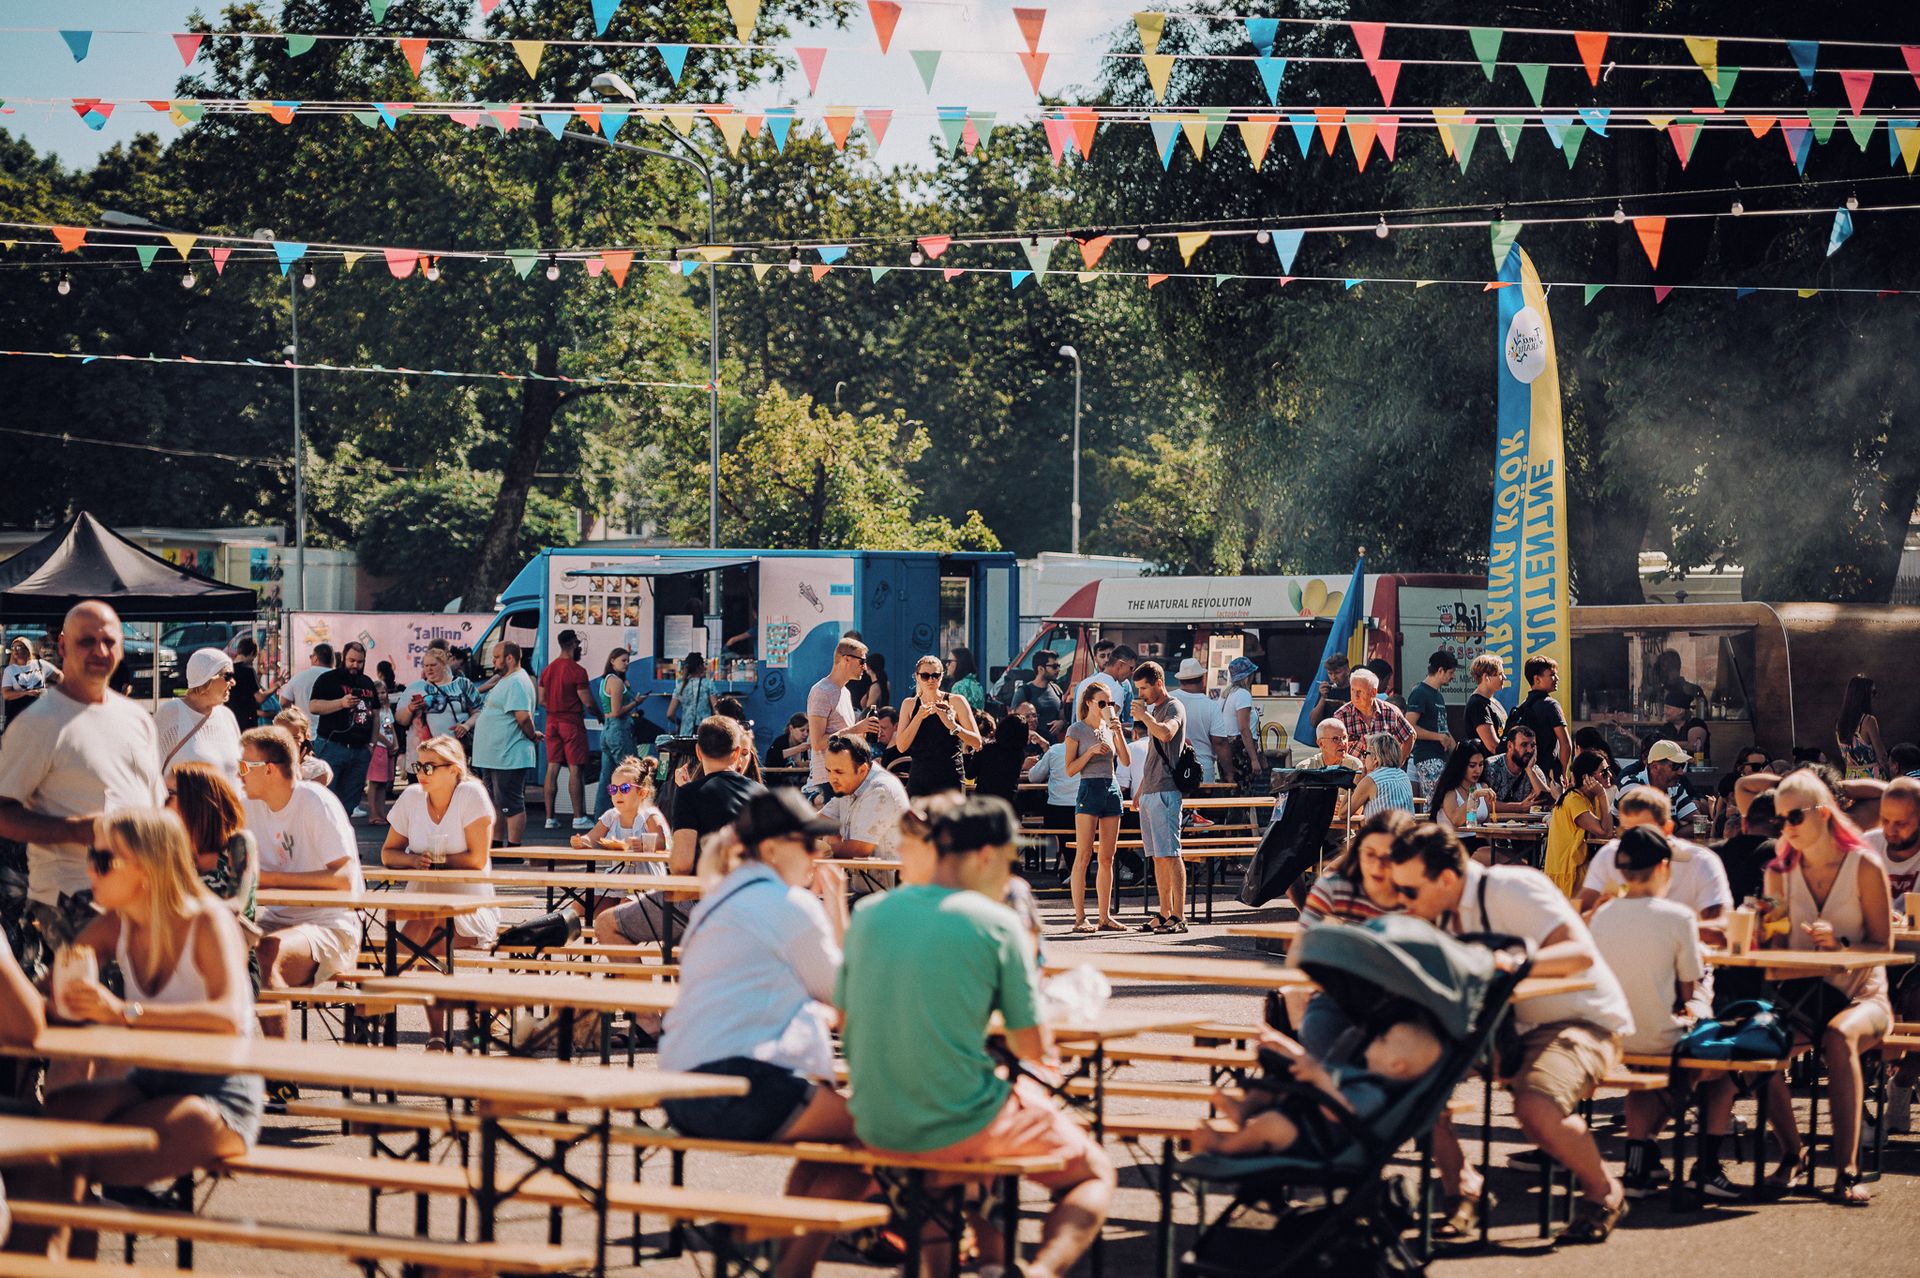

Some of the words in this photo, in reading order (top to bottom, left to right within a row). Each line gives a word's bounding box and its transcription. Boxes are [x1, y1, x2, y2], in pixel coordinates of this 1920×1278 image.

[1128, 600, 1145, 610] THE
[1147, 598, 1189, 610] NATURAL
[1192, 596, 1252, 609] REVOLUTION
[1238, 609, 1250, 618] free
[415, 626, 462, 640] Tallinn
